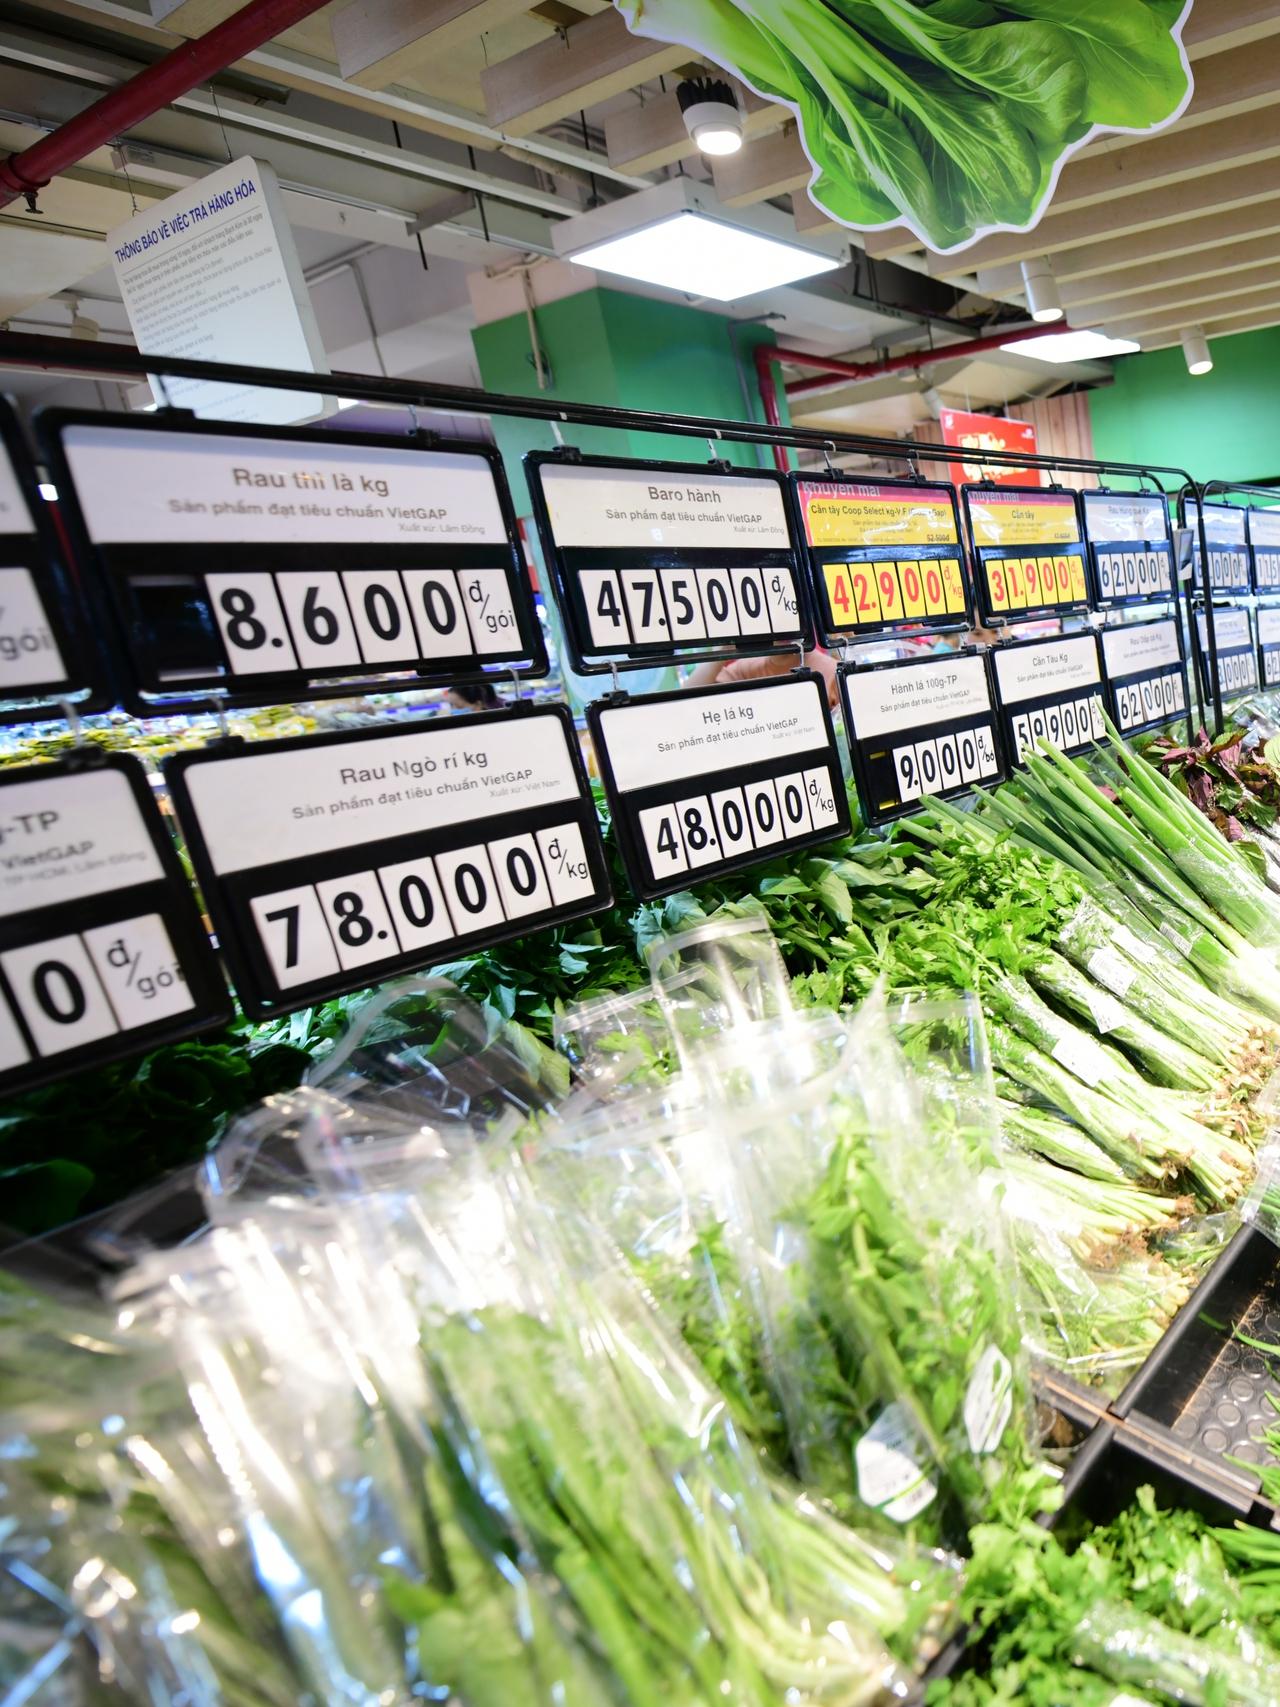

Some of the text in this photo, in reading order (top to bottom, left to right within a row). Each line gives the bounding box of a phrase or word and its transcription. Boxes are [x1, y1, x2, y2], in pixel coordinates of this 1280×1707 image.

[115, 239, 142, 263] THÔNG
[142, 229, 158, 251] BÁO
[158, 218, 171, 240] VỀ
[170, 212, 190, 235] VIỆC
[208, 190, 234, 216] HÀNG
[232, 467, 286, 489] Rau
[333, 473, 354, 493] là
[361, 475, 390, 498] kg
[648, 486, 722, 503] Baro hành
[169, 499, 448, 521] Sản phẩm đạt tiêu chuẩn VietGAP
[605, 509, 763, 524] Sản phẩm đạt tiêu chuẩn VietGAP
[842, 506, 862, 517] Coop
[864, 506, 885, 516] Select
[833, 567, 940, 613] 42.900
[991, 561, 1068, 602] 31.900
[1102, 558, 1157, 587] 62.000
[220, 580, 458, 650] 8.600
[597, 575, 800, 627] 47.500 đ/kg
[1060, 653, 1069, 664] Kg
[890, 674, 958, 695] Hành lá 100g-TP
[1121, 682, 1172, 720] 62.000
[702, 705, 755, 726] Hẹ lá kg
[657, 717, 799, 753] Sản phẩm đạt tiêu chuẩn VietGAP
[340, 751, 489, 785] Rau Ngò rí kg
[900, 738, 975, 789] 9.000
[291, 768, 534, 820] Sản phẩm đạt tiêu chuẩn VietGAP
[657, 779, 835, 860] 48.000 đ/kg
[265, 838, 588, 969] 78.000 đ/kg
